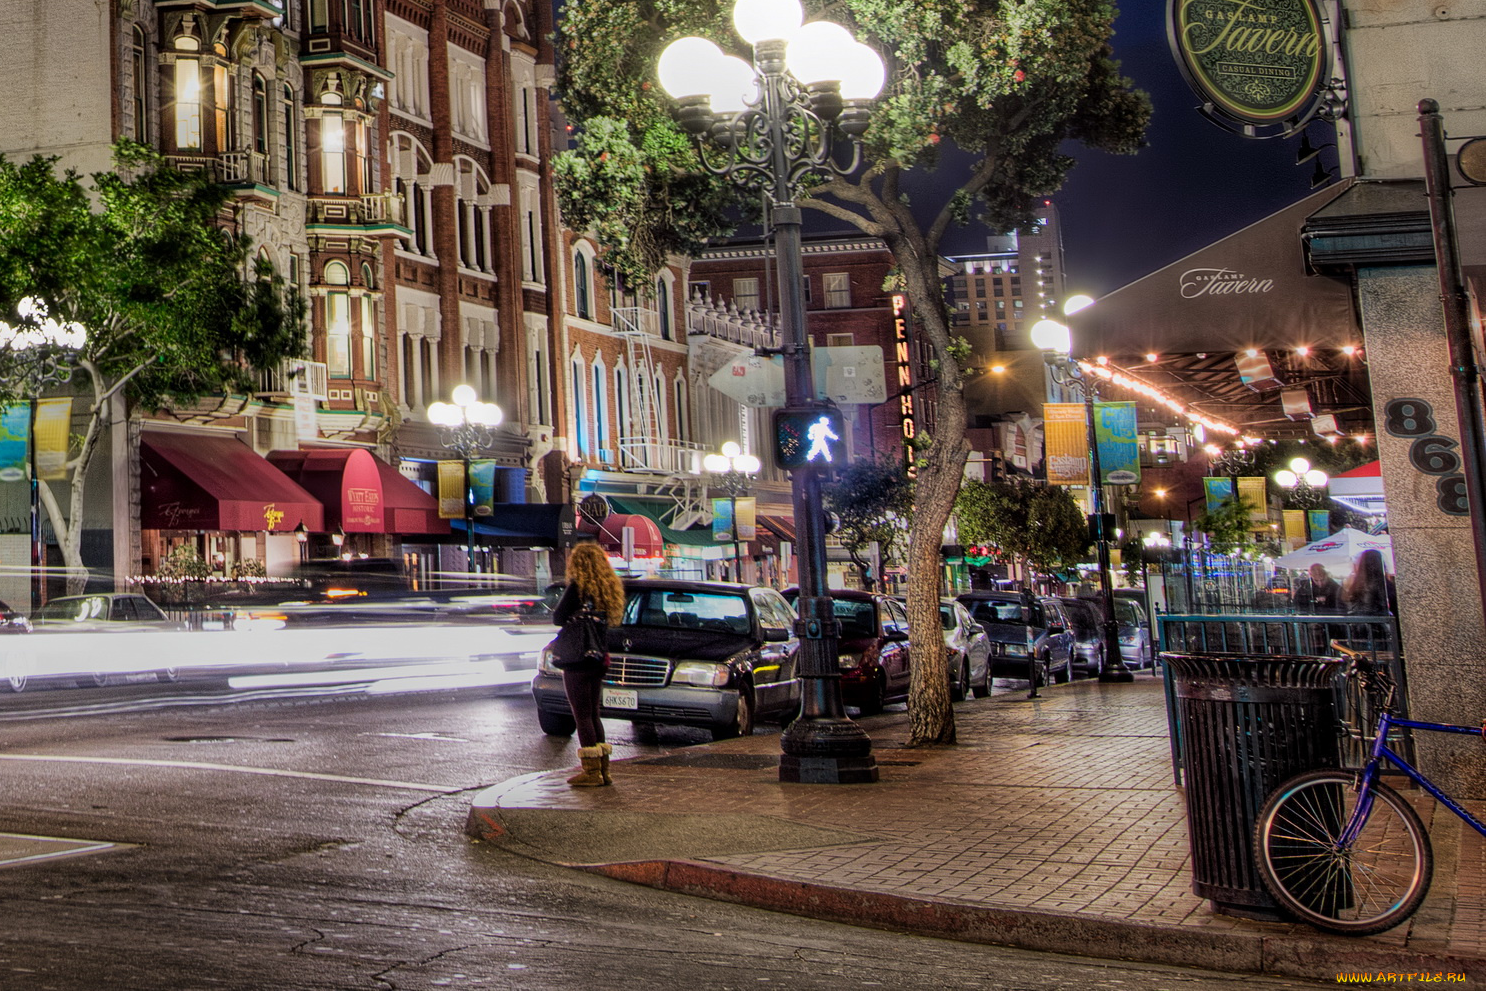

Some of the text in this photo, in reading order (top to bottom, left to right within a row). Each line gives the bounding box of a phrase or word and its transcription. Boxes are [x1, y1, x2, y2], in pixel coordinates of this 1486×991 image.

[1205, 10, 1279, 24] GASLAMP
[1221, 64, 1291, 77] CASUAL DINING
[1179, 267, 1274, 299] Tavern
[892, 295, 911, 387] PENN
[1384, 397, 1471, 517] 868
